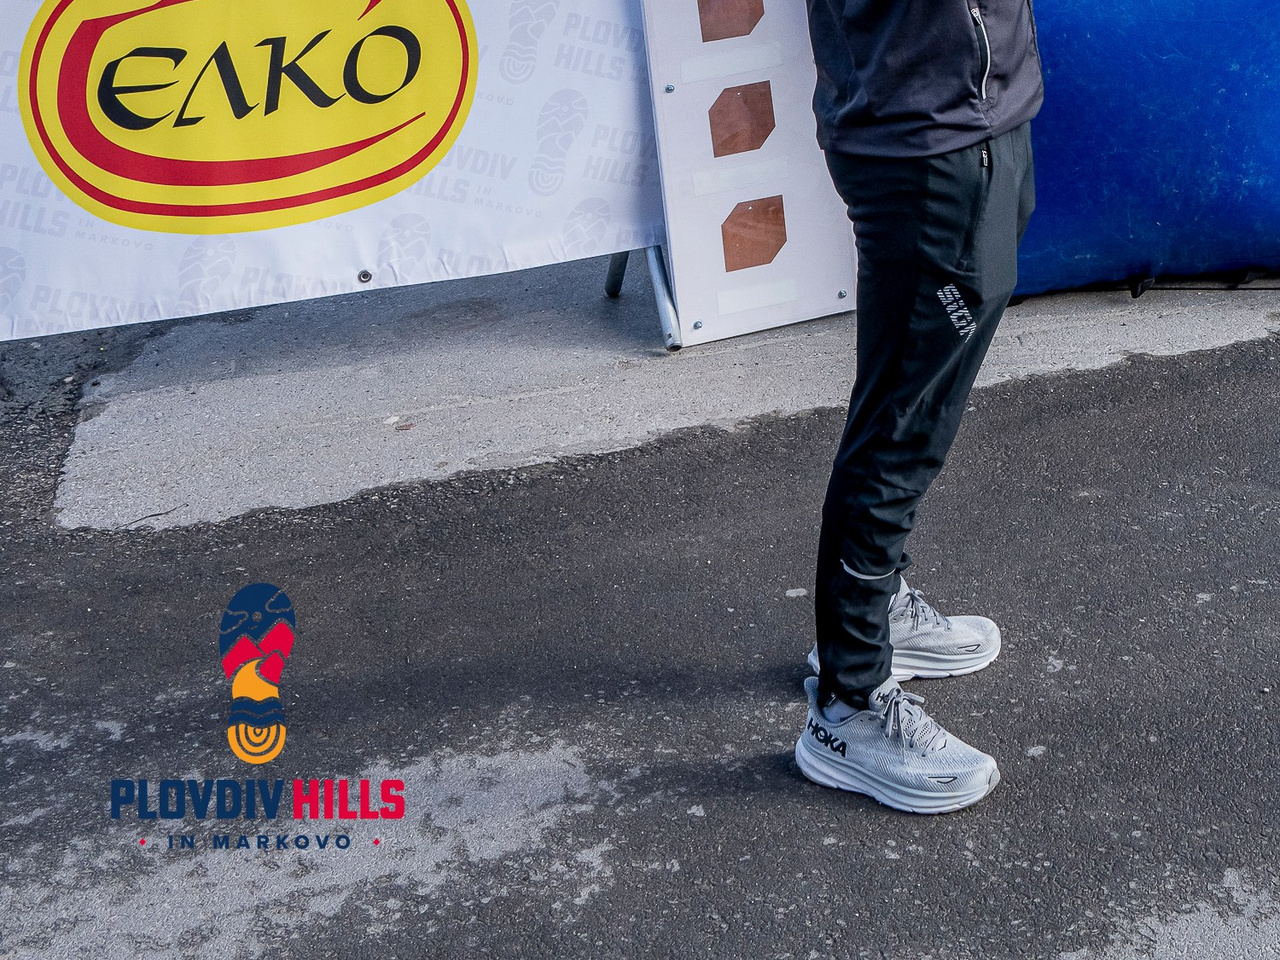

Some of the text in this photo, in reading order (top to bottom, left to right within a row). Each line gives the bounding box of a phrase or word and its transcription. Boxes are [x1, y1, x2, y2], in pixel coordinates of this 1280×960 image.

[555, 43, 626, 82] HILLS
[75, 230, 155, 251] MARKOVO
[807, 717, 848, 759] HOKA
